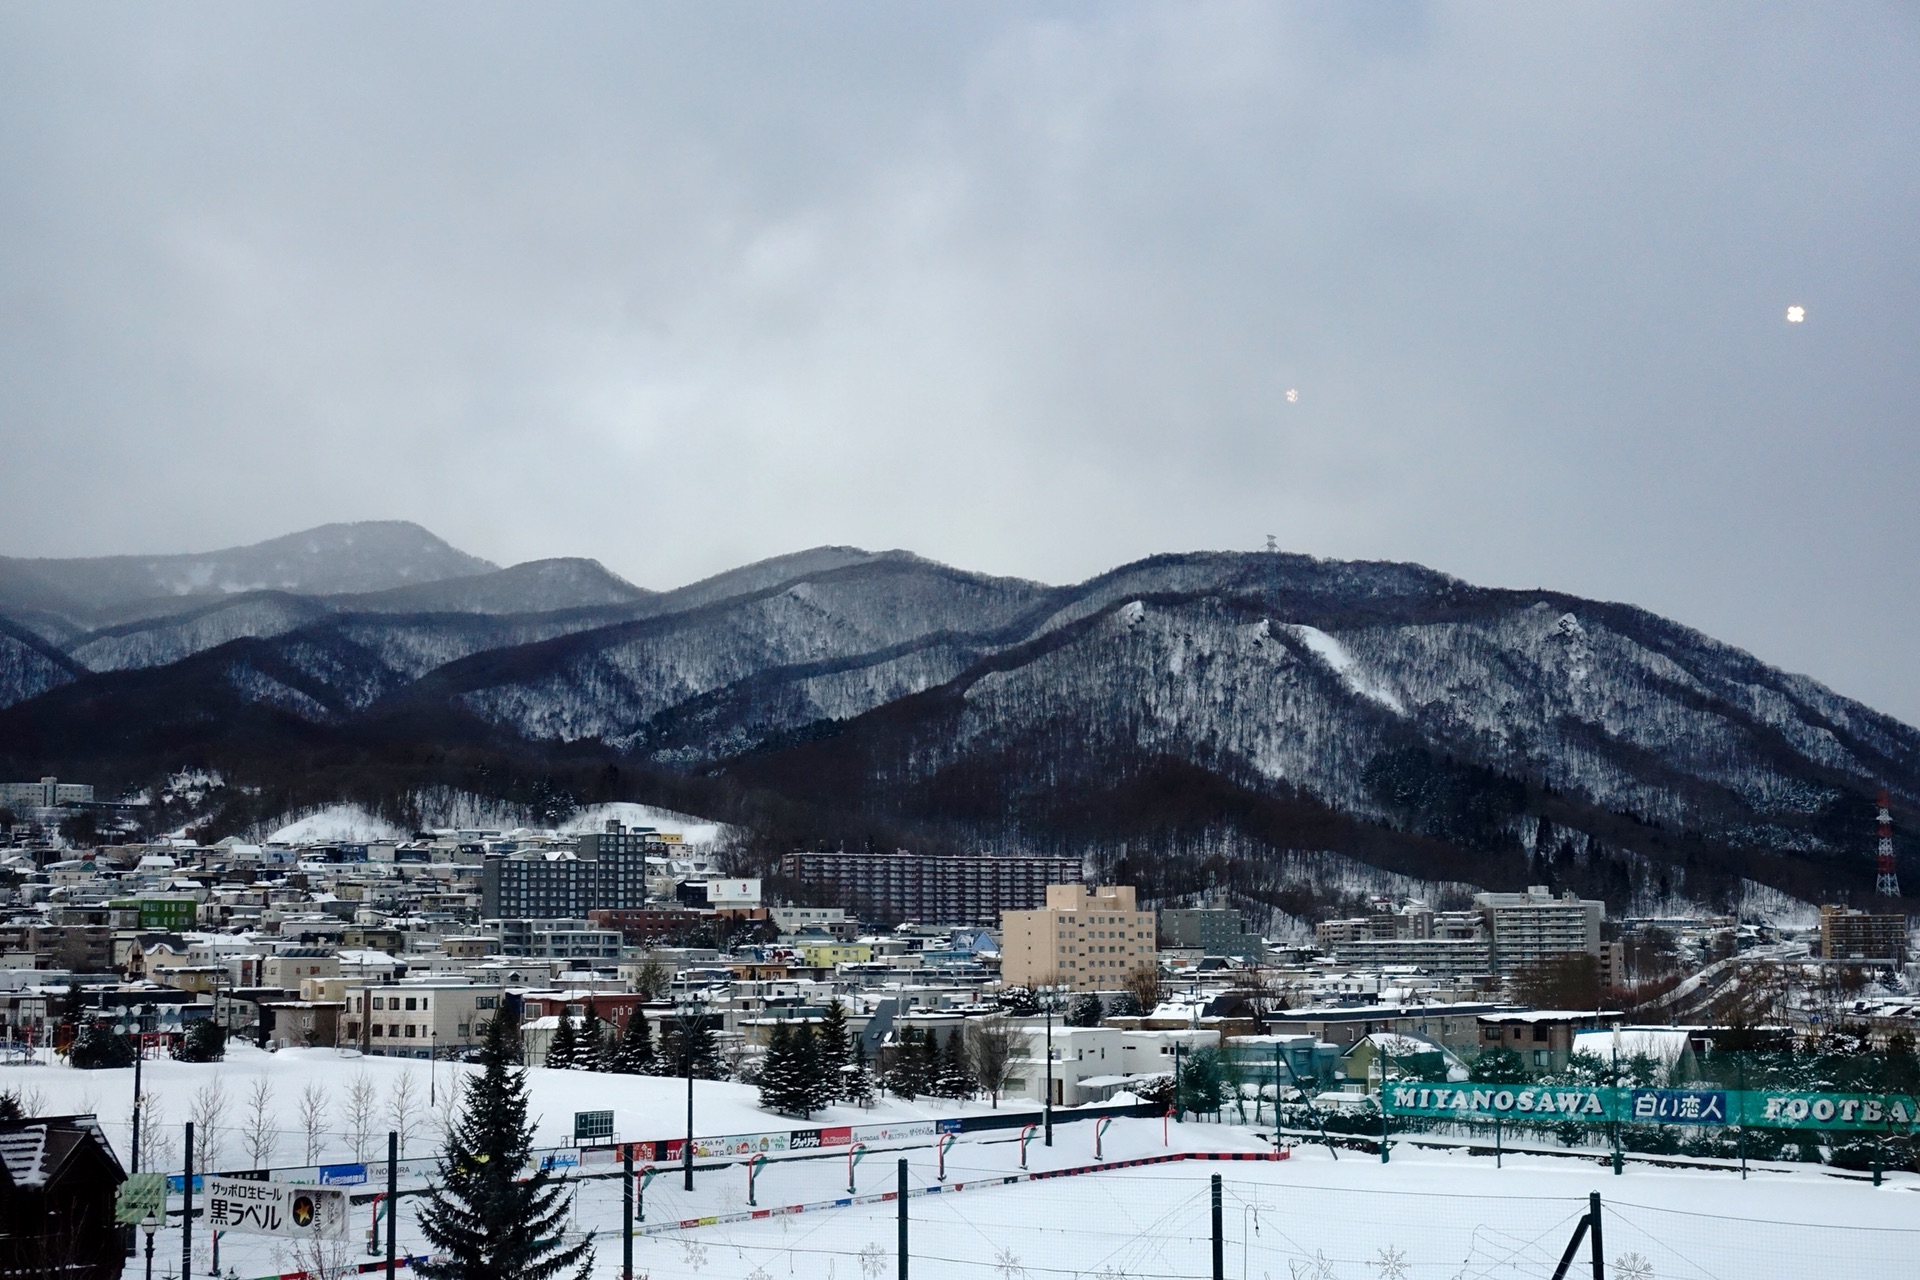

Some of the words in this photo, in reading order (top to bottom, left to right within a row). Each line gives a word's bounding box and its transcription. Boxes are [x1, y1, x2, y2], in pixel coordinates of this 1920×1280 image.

[1394, 1087, 1604, 1115] MIYANOSAWA
[1634, 1091, 1724, 1119] 白い恋人
[211, 1182, 282, 1202] サッポロ生ビール
[210, 1198, 282, 1231] 黒ラベル
